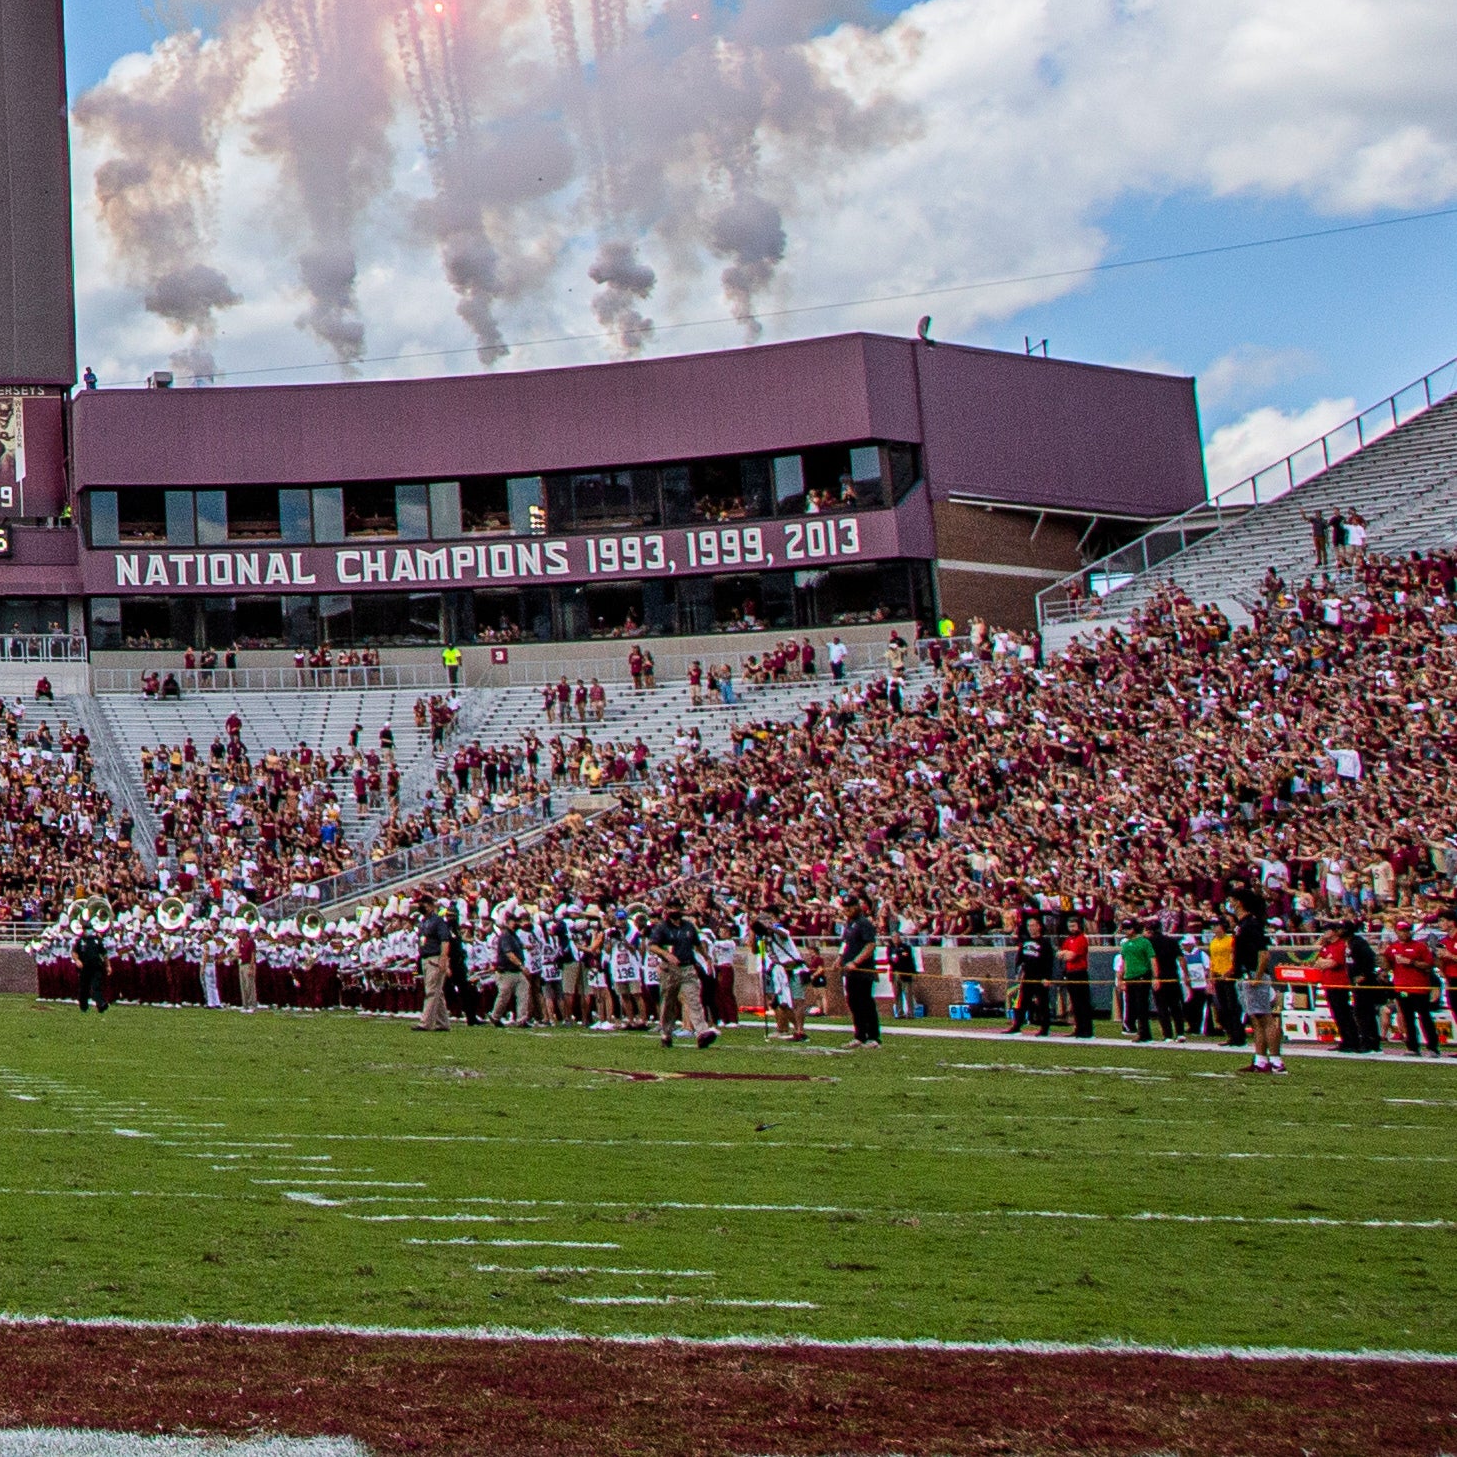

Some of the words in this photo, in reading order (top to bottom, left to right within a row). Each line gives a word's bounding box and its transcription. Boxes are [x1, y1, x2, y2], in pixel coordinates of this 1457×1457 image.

[0, 486, 13, 508] 9
[114, 551, 317, 587] NATIONAL
[336, 541, 571, 585] CHAMPIONS
[586, 535, 678, 576] 1993,
[687, 527, 774, 568] 1999,
[784, 518, 861, 561] 2013
[495, 650, 504, 661] 3
